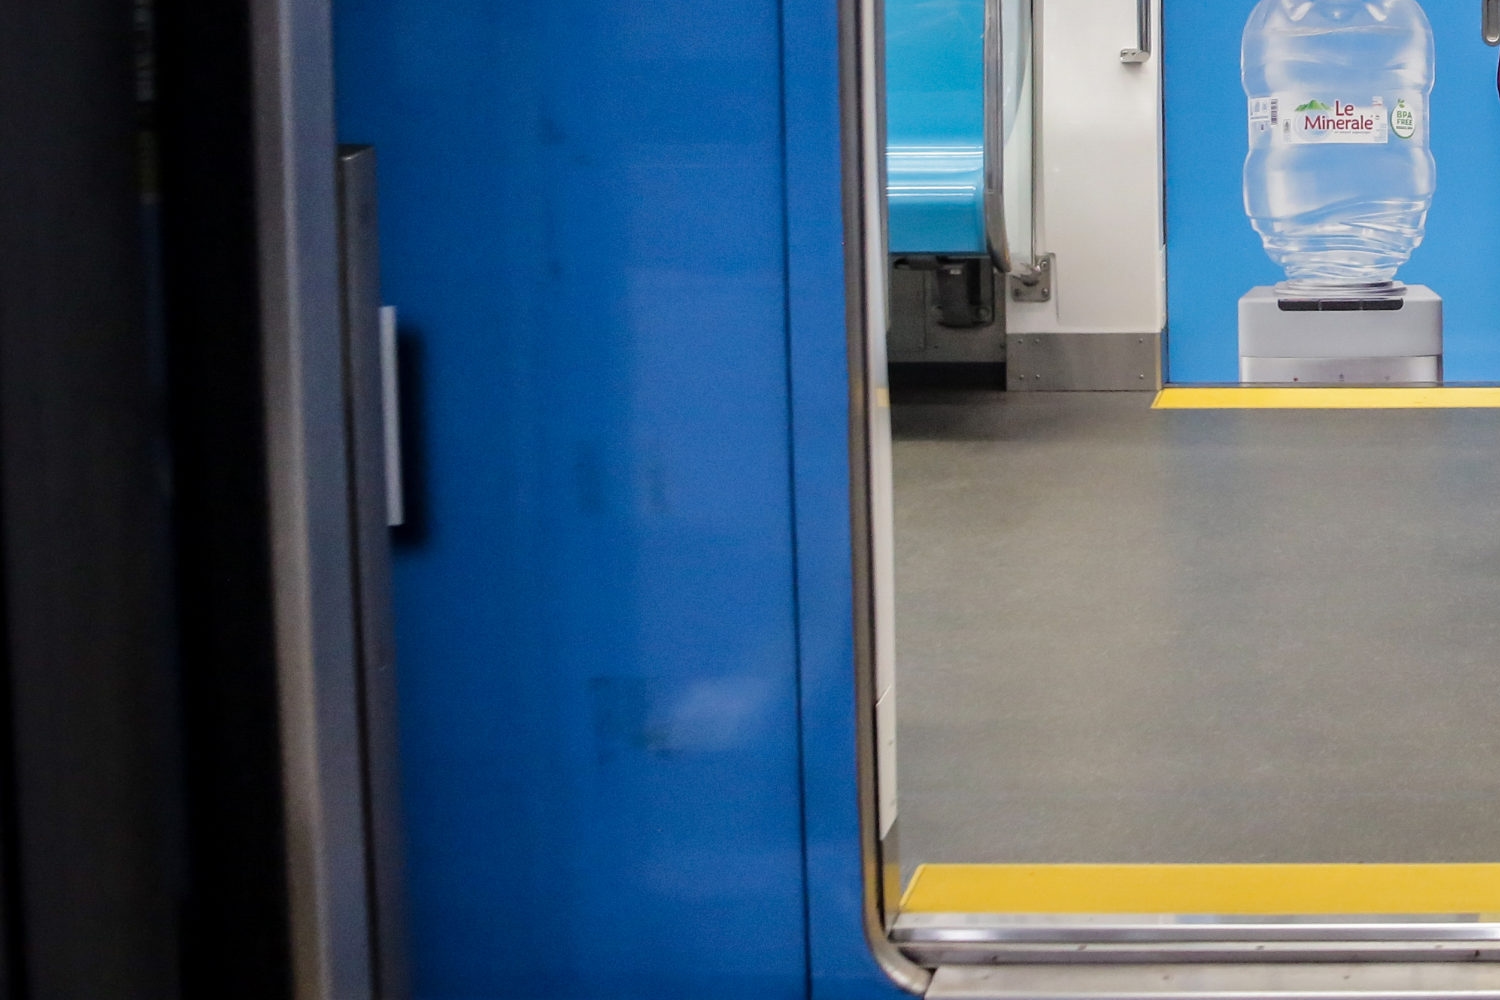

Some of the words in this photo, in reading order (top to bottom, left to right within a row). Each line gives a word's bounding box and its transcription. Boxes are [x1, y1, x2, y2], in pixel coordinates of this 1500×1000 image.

[1335, 100, 1354, 116] Le
[1396, 111, 1413, 119] BPA
[1304, 114, 1373, 130] Minerale
